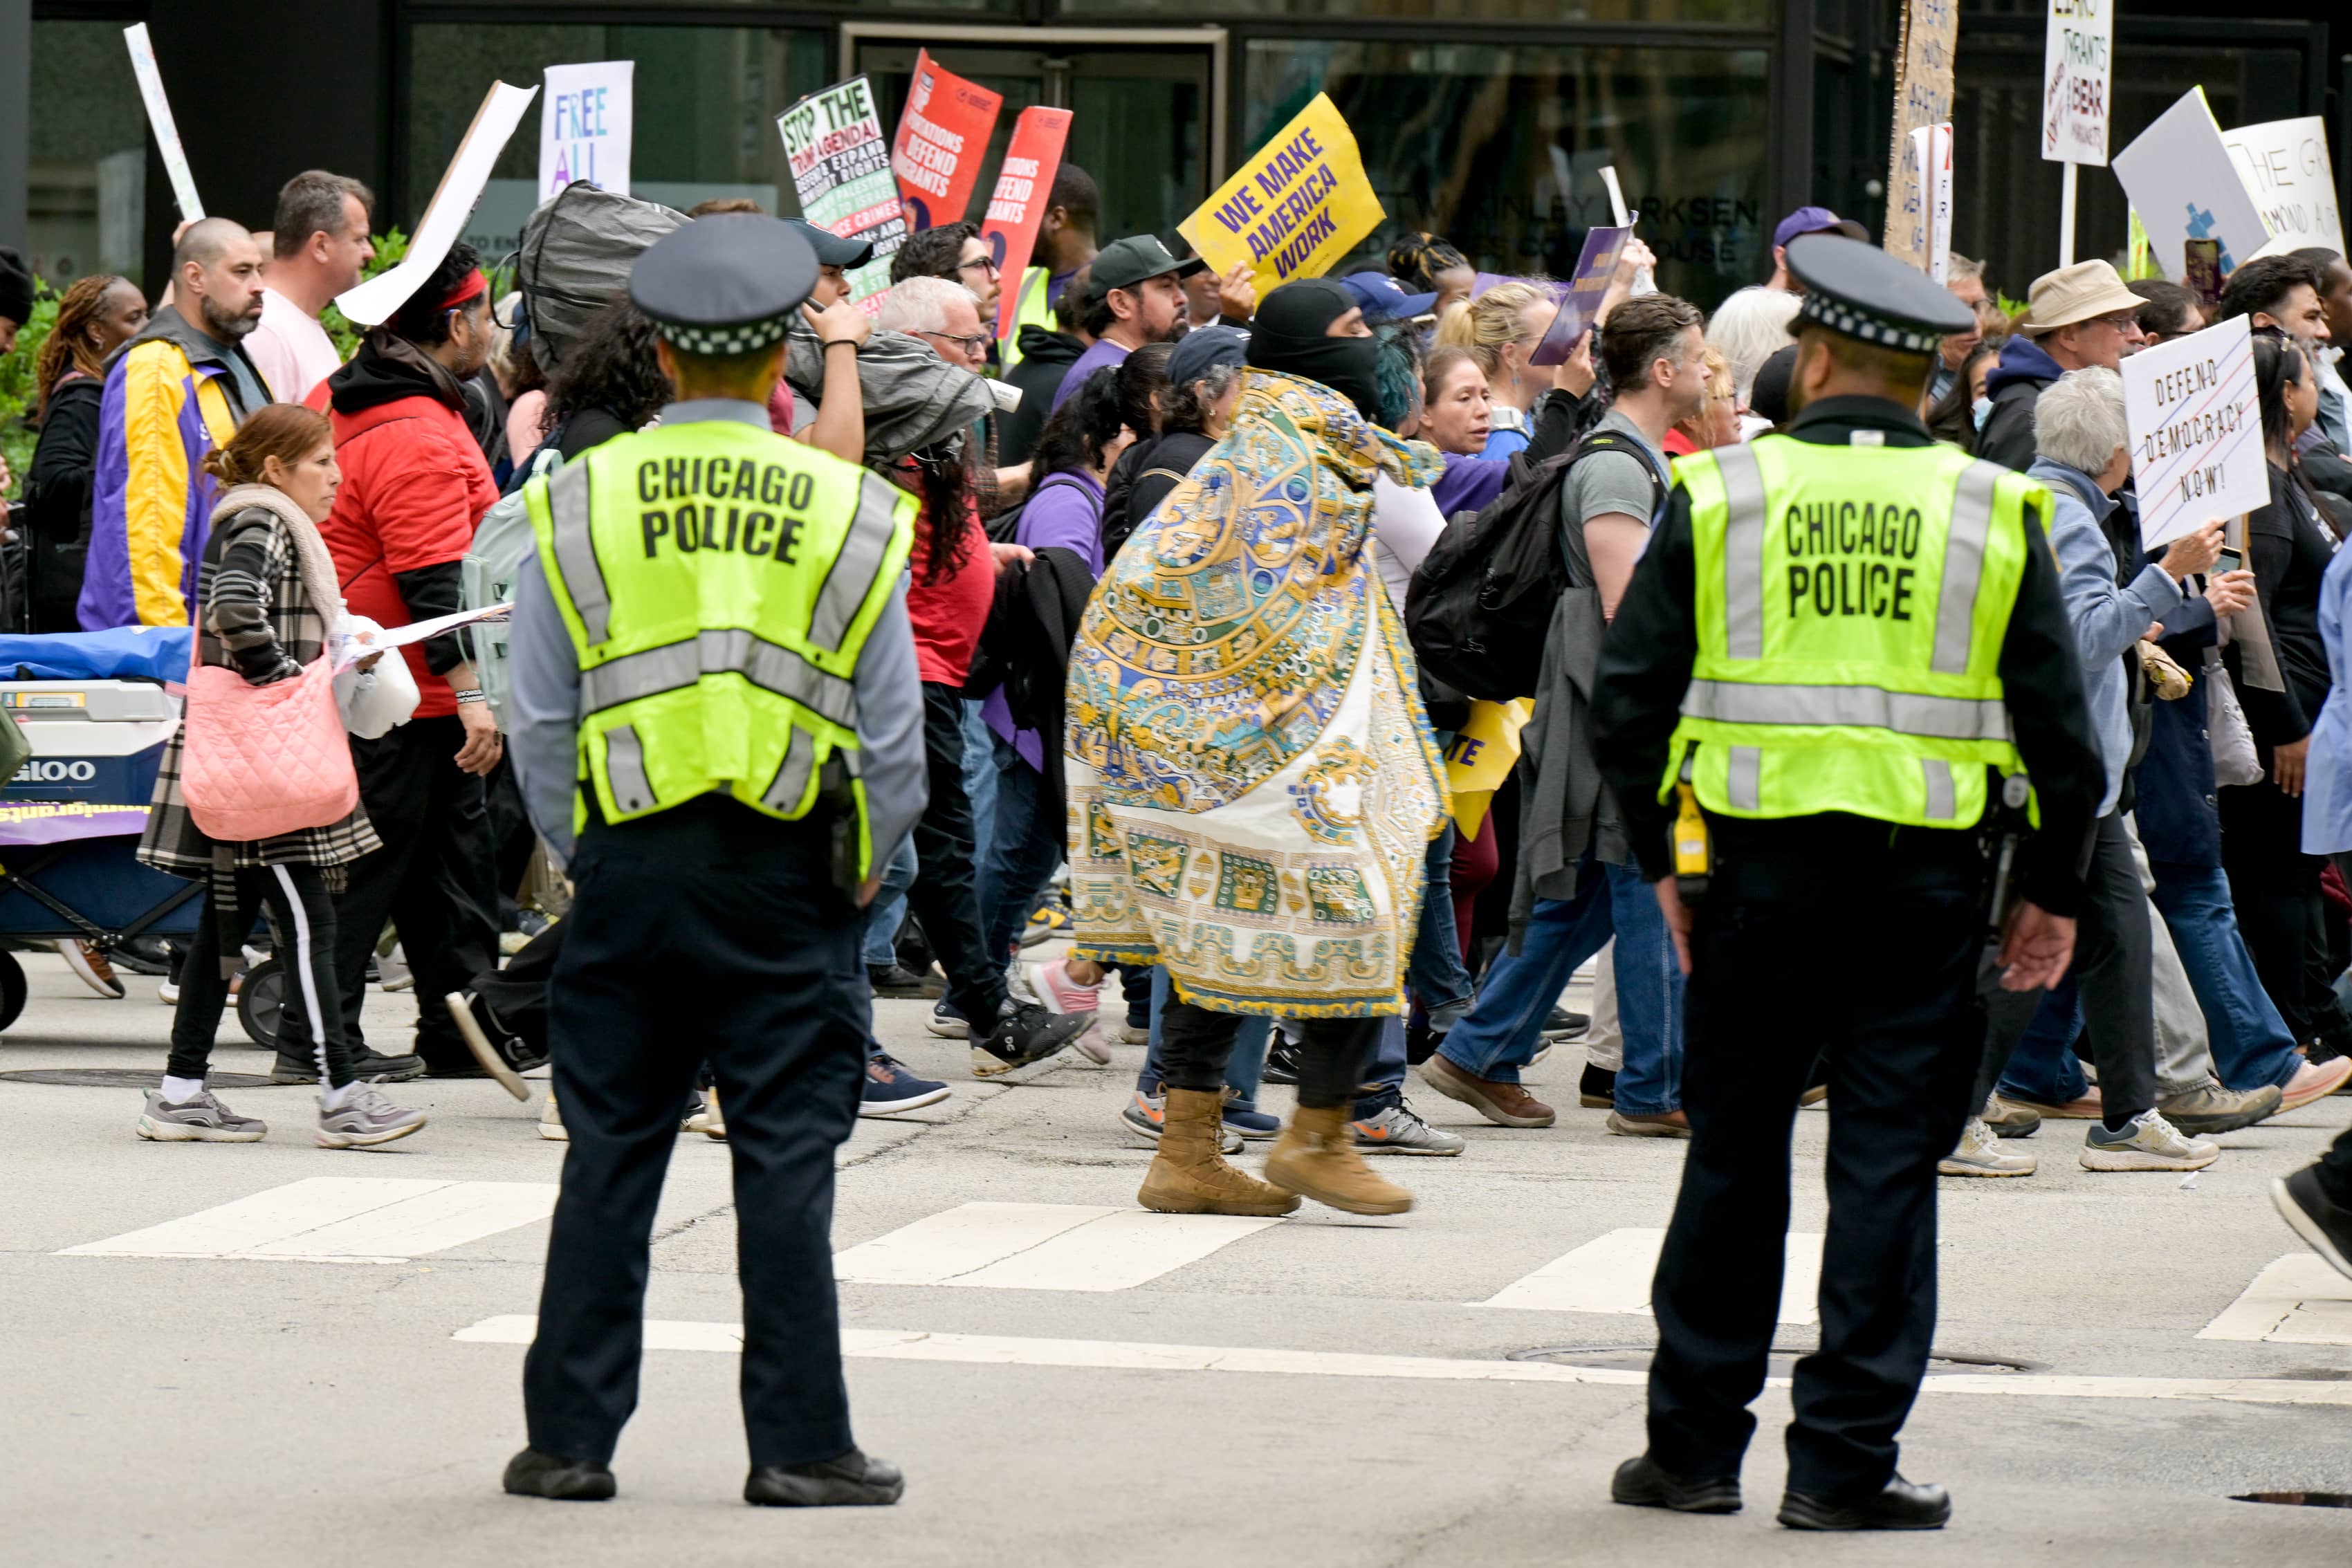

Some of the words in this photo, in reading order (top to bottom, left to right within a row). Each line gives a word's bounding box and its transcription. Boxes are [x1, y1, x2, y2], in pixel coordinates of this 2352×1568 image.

[555, 87, 607, 140] FREE
[783, 105, 815, 154] STOP
[819, 83, 870, 130] THE
[832, 139, 886, 171] EXPAND
[840, 153, 890, 183] RIGHTS
[906, 133, 958, 178] DEFEND
[1213, 185, 1264, 234] WE
[1254, 127, 1324, 199] MAKE
[854, 199, 901, 227] CRIMES
[879, 218, 907, 240] AND
[1246, 163, 1339, 264] AMERICA
[1273, 205, 1337, 279] WORK
[2155, 358, 2217, 407] DEFEND
[2144, 401, 2243, 463] DEMOCRACY
[638, 457, 814, 510] CHICAGO
[2179, 462, 2225, 504] NOW!
[641, 504, 805, 566] POLICE
[1787, 501, 1921, 560] CHICAGO
[1788, 562, 1915, 620] POLICE
[12, 761, 96, 781] GLOO
[1449, 733, 1485, 767] TE
